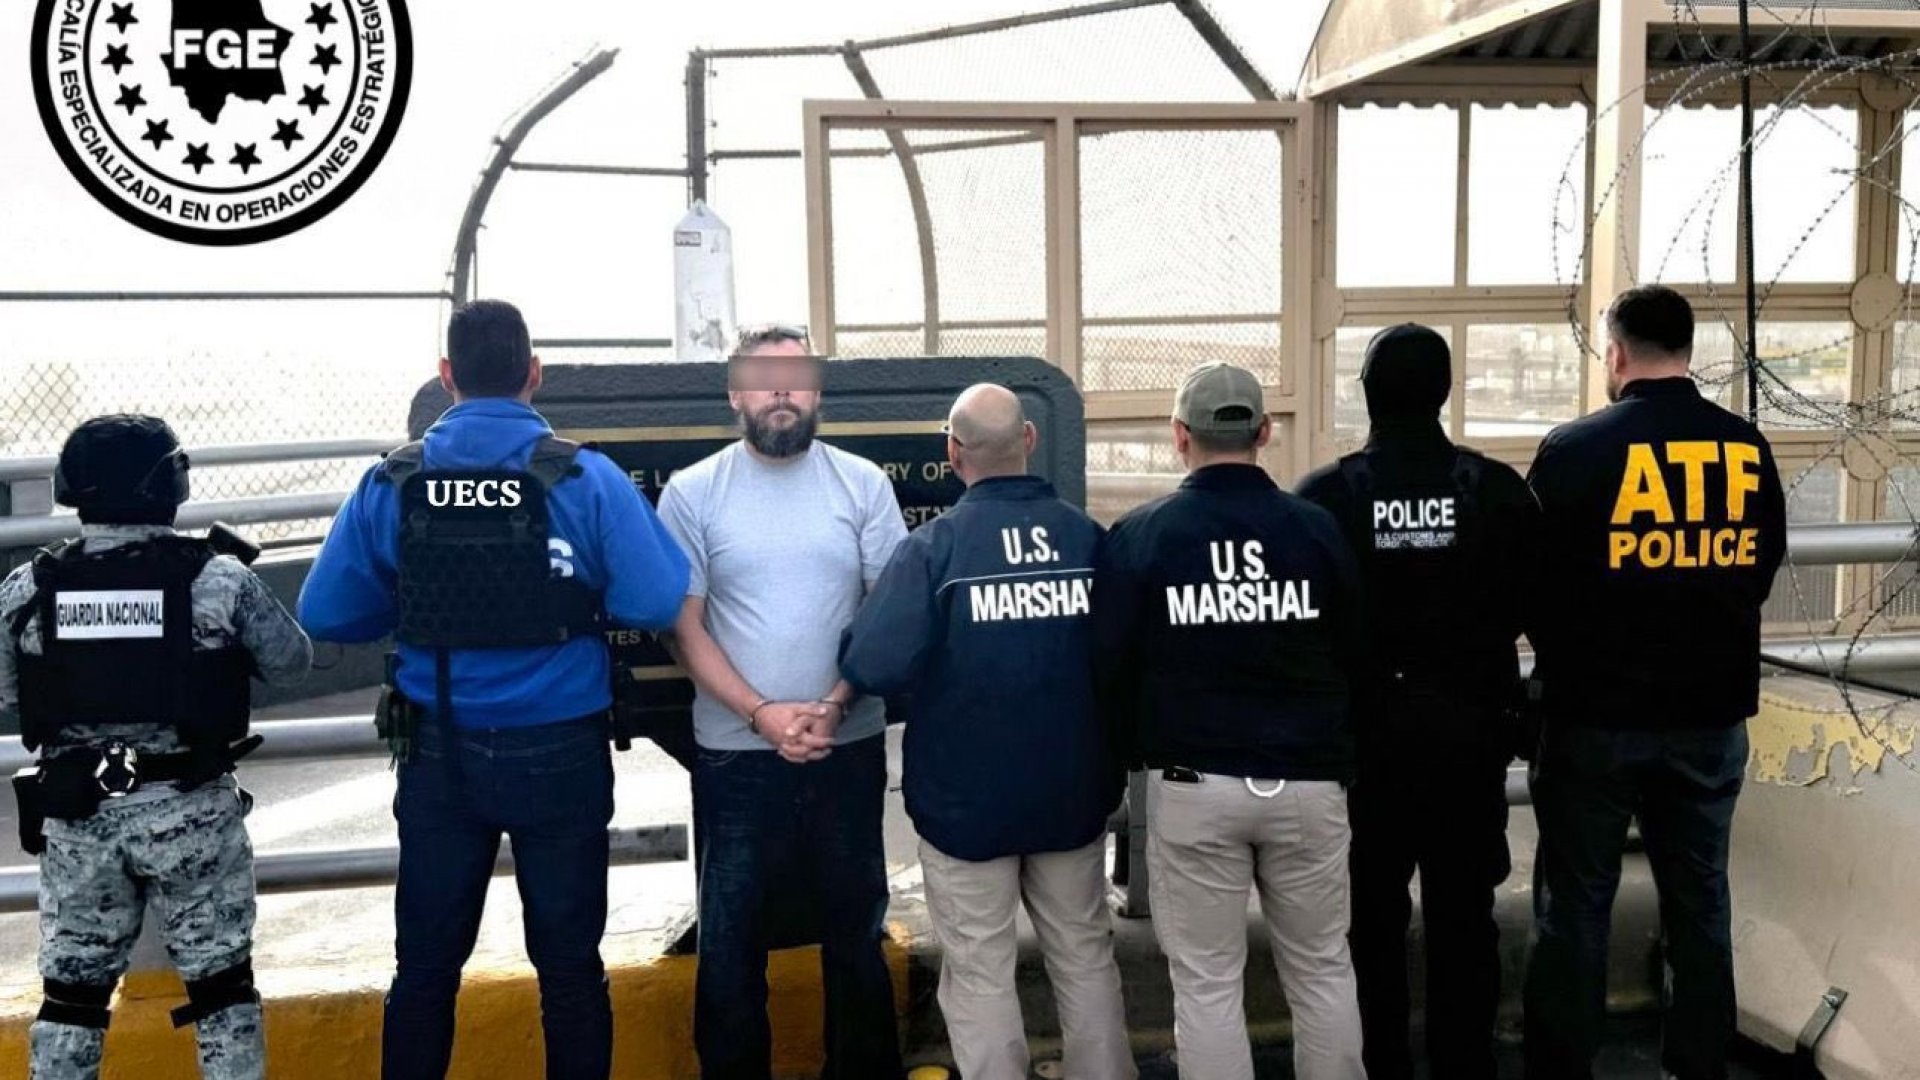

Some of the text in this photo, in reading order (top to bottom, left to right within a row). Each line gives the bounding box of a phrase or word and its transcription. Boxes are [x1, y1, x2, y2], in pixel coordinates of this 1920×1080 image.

[426, 480, 521, 507] UECS
[1610, 440, 1760, 524] ATF
[1373, 497, 1456, 529] POLICE
[1002, 526, 1060, 565] U.S.
[1210, 540, 1271, 582] U.S.
[1609, 528, 1758, 569] POLICE
[57, 601, 162, 627] GUARDIA NACIONAL
[969, 578, 1093, 623] MARSHA
[1166, 580, 1321, 626] MARSHAL
